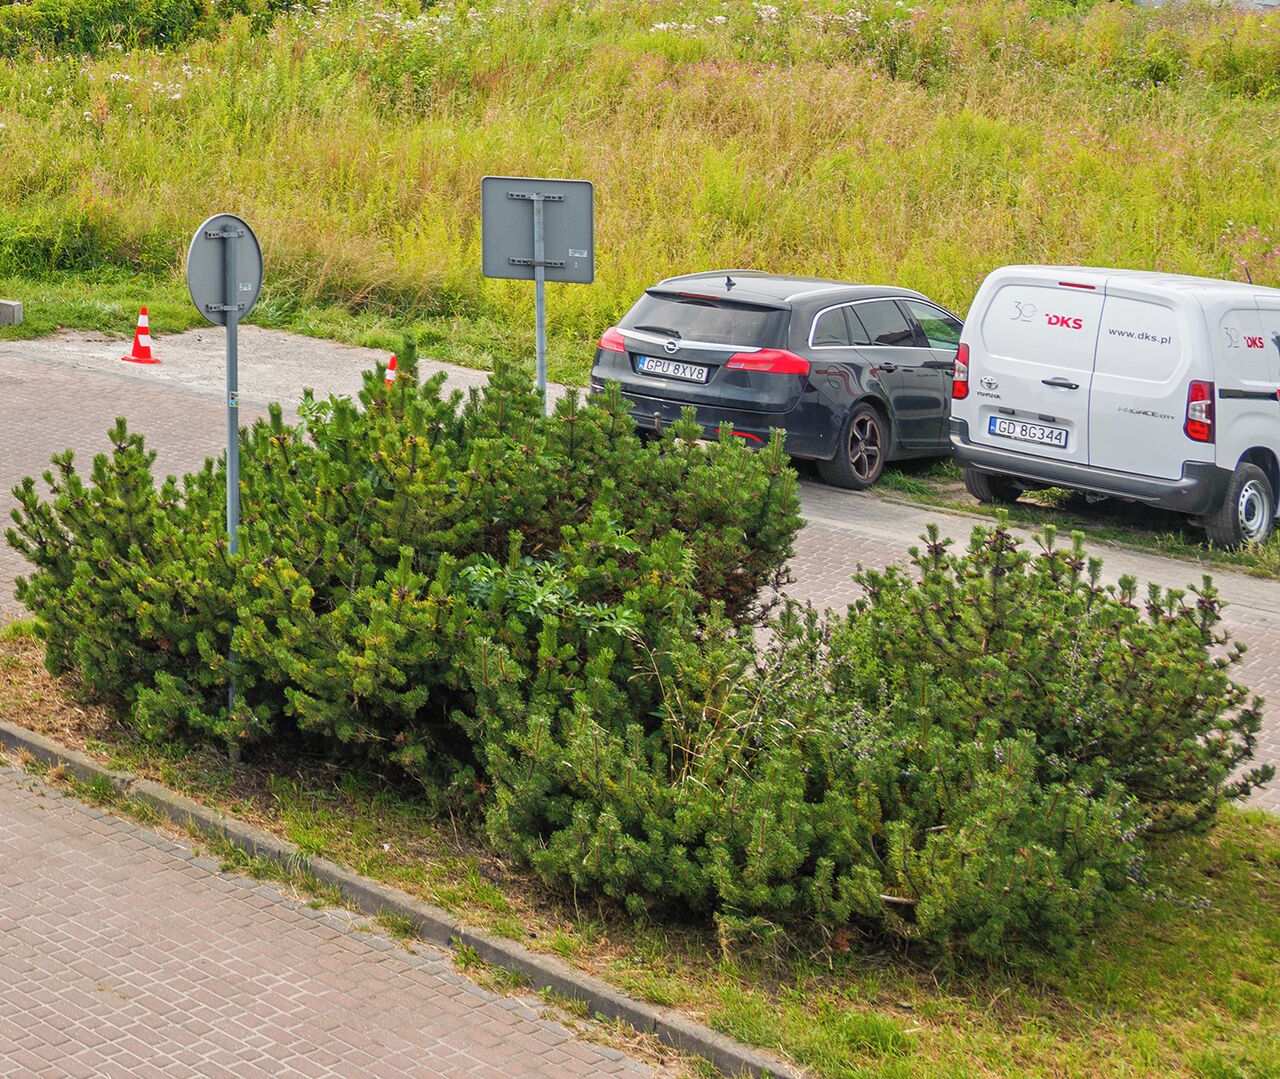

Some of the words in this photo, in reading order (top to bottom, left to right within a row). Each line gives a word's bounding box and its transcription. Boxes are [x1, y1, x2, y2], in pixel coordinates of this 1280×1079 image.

[1045, 313, 1083, 330] DKS
[1108, 328, 1172, 345] www.dks.pl
[1243, 336, 1265, 349] DKS
[646, 359, 671, 373] GPU
[672, 363, 705, 380] 8XV8
[998, 420, 1016, 435] GD
[1019, 424, 1063, 444] 8G344
